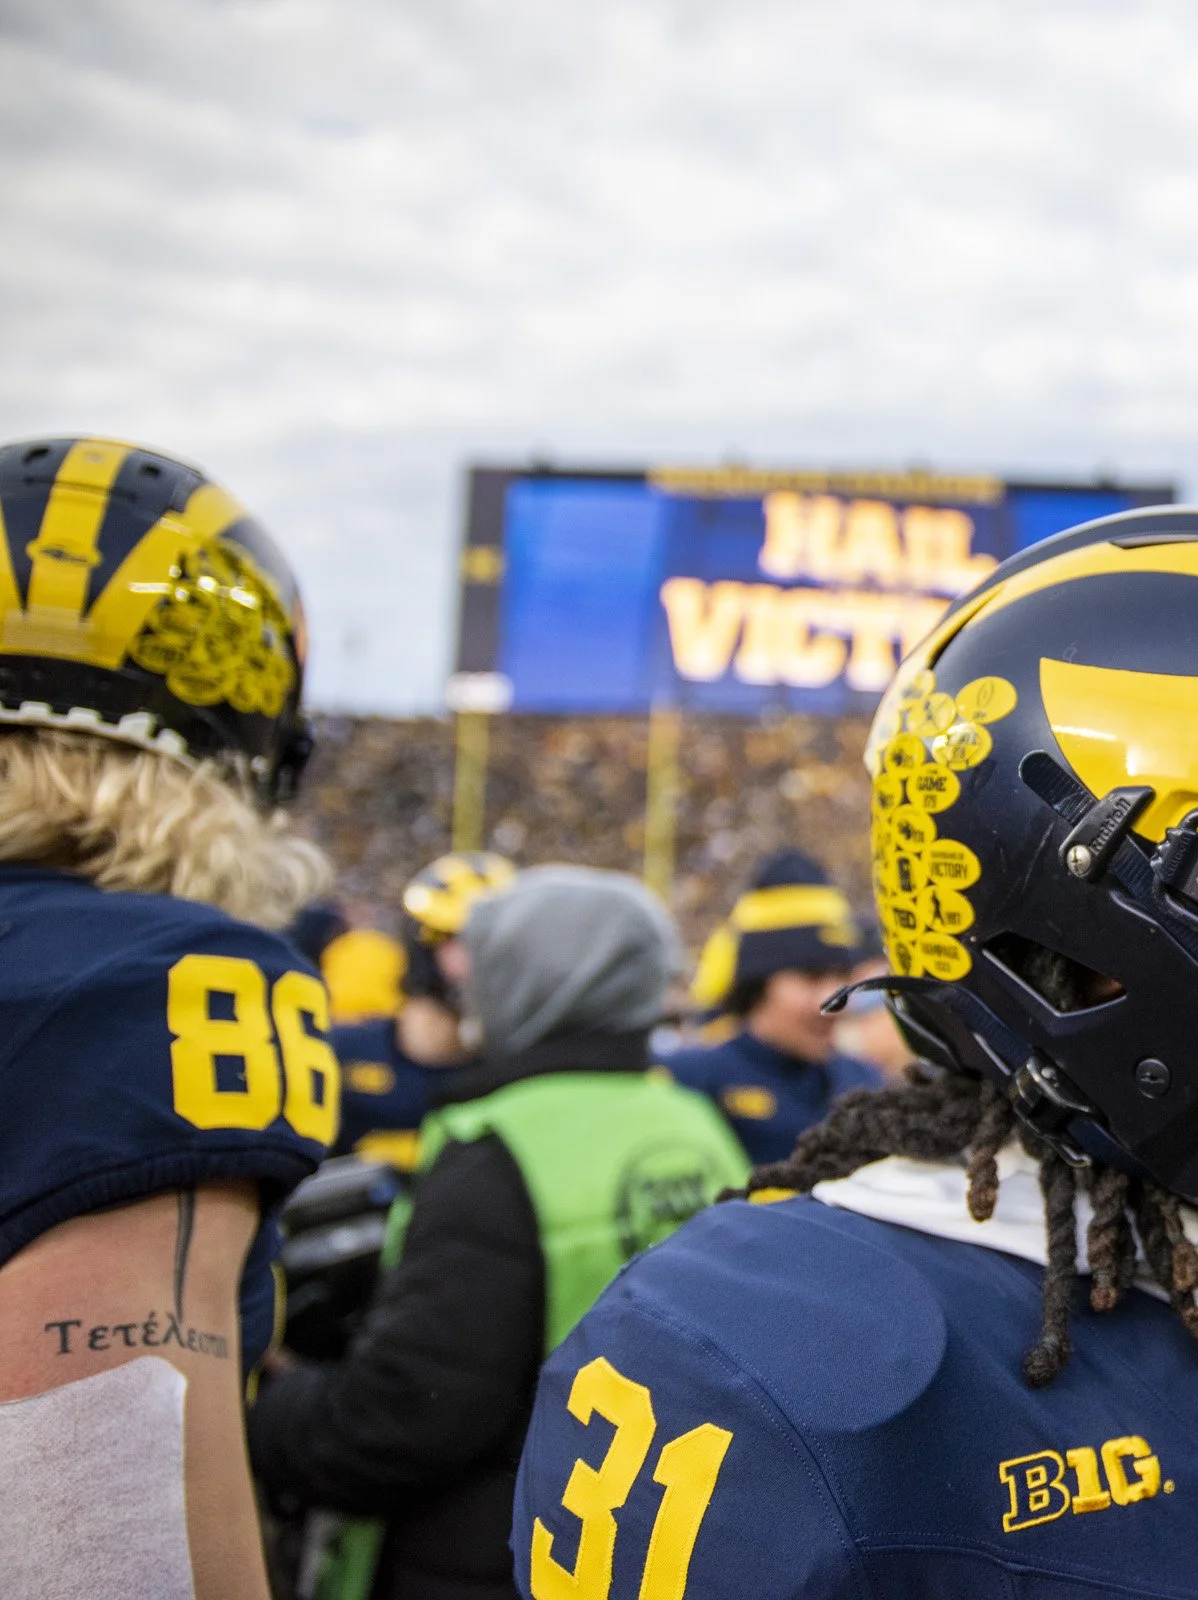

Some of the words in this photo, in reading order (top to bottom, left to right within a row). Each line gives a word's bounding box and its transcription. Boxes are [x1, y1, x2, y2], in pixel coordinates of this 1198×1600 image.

[1089, 797, 1131, 856] Riddell
[167, 954, 340, 1147] 86
[531, 1356, 734, 1600] 31
